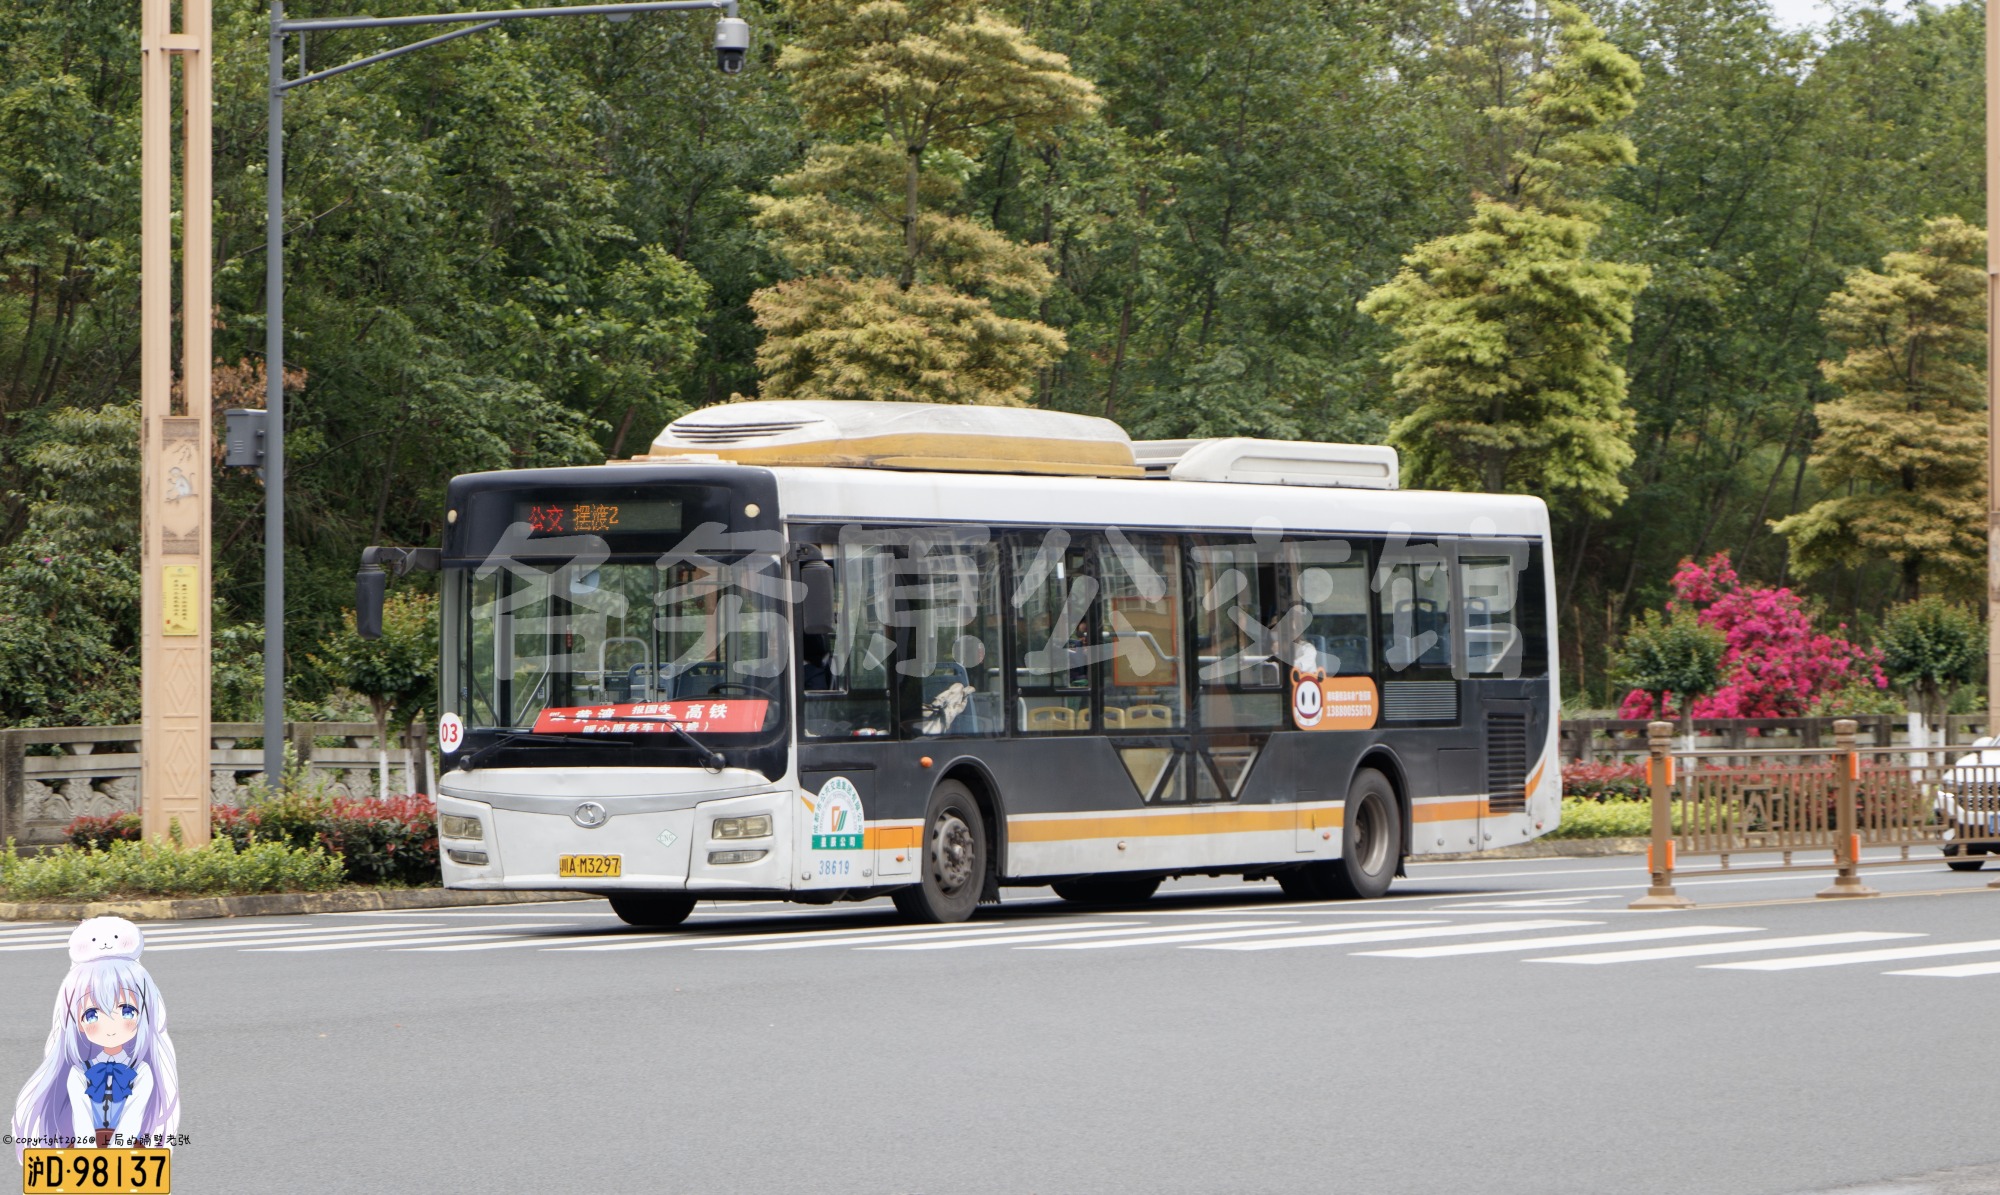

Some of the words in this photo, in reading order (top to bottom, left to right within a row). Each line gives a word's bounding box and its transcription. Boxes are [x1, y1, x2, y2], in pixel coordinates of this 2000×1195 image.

[529, 505, 564, 532] 公交
[572, 504, 619, 531] 摆渡2
[631, 704, 671, 715] 报国寺
[684, 703, 728, 719] 高铁
[441, 723, 458, 743] 03
[819, 860, 850, 875] 38619
